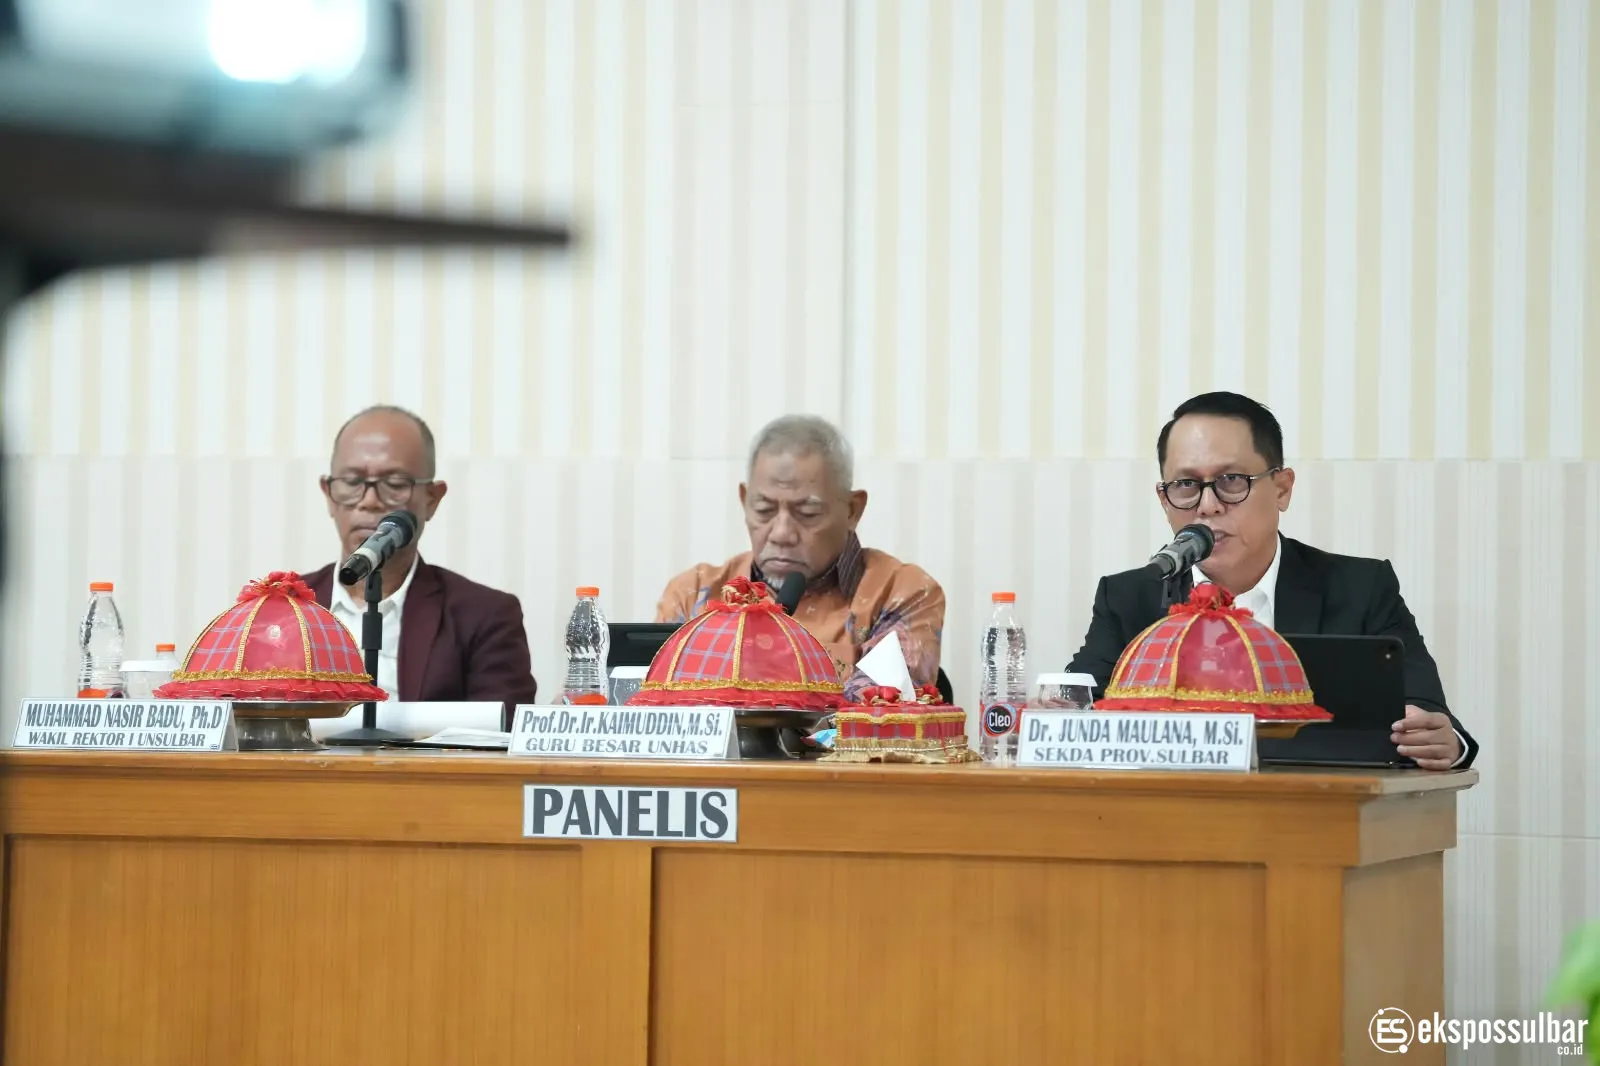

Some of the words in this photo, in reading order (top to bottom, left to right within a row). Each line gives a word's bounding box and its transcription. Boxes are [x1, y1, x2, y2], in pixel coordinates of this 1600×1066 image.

[25, 703, 101, 728] MUHAMMAD
[104, 704, 145, 729] NASIR
[146, 704, 186, 731] BADU,
[190, 705, 223, 730] Ph.D
[989, 711, 1011, 728] Cleo
[28, 731, 68, 746] WAKIL
[72, 732, 126, 747] REKTOR
[128, 733, 135, 747] I
[138, 732, 206, 748] UNSULBAR
[1028, 718, 1053, 743] Dr.
[1058, 719, 1111, 743] JUNDA
[1117, 719, 1198, 748] MAULANA,
[1203, 721, 1244, 746] M.Si.
[526, 738, 577, 752] GURU
[582, 738, 641, 754] BESAR
[649, 739, 708, 755] UNHAS
[1033, 747, 1094, 763] SEKDA
[532, 788, 729, 839] PANELIS
